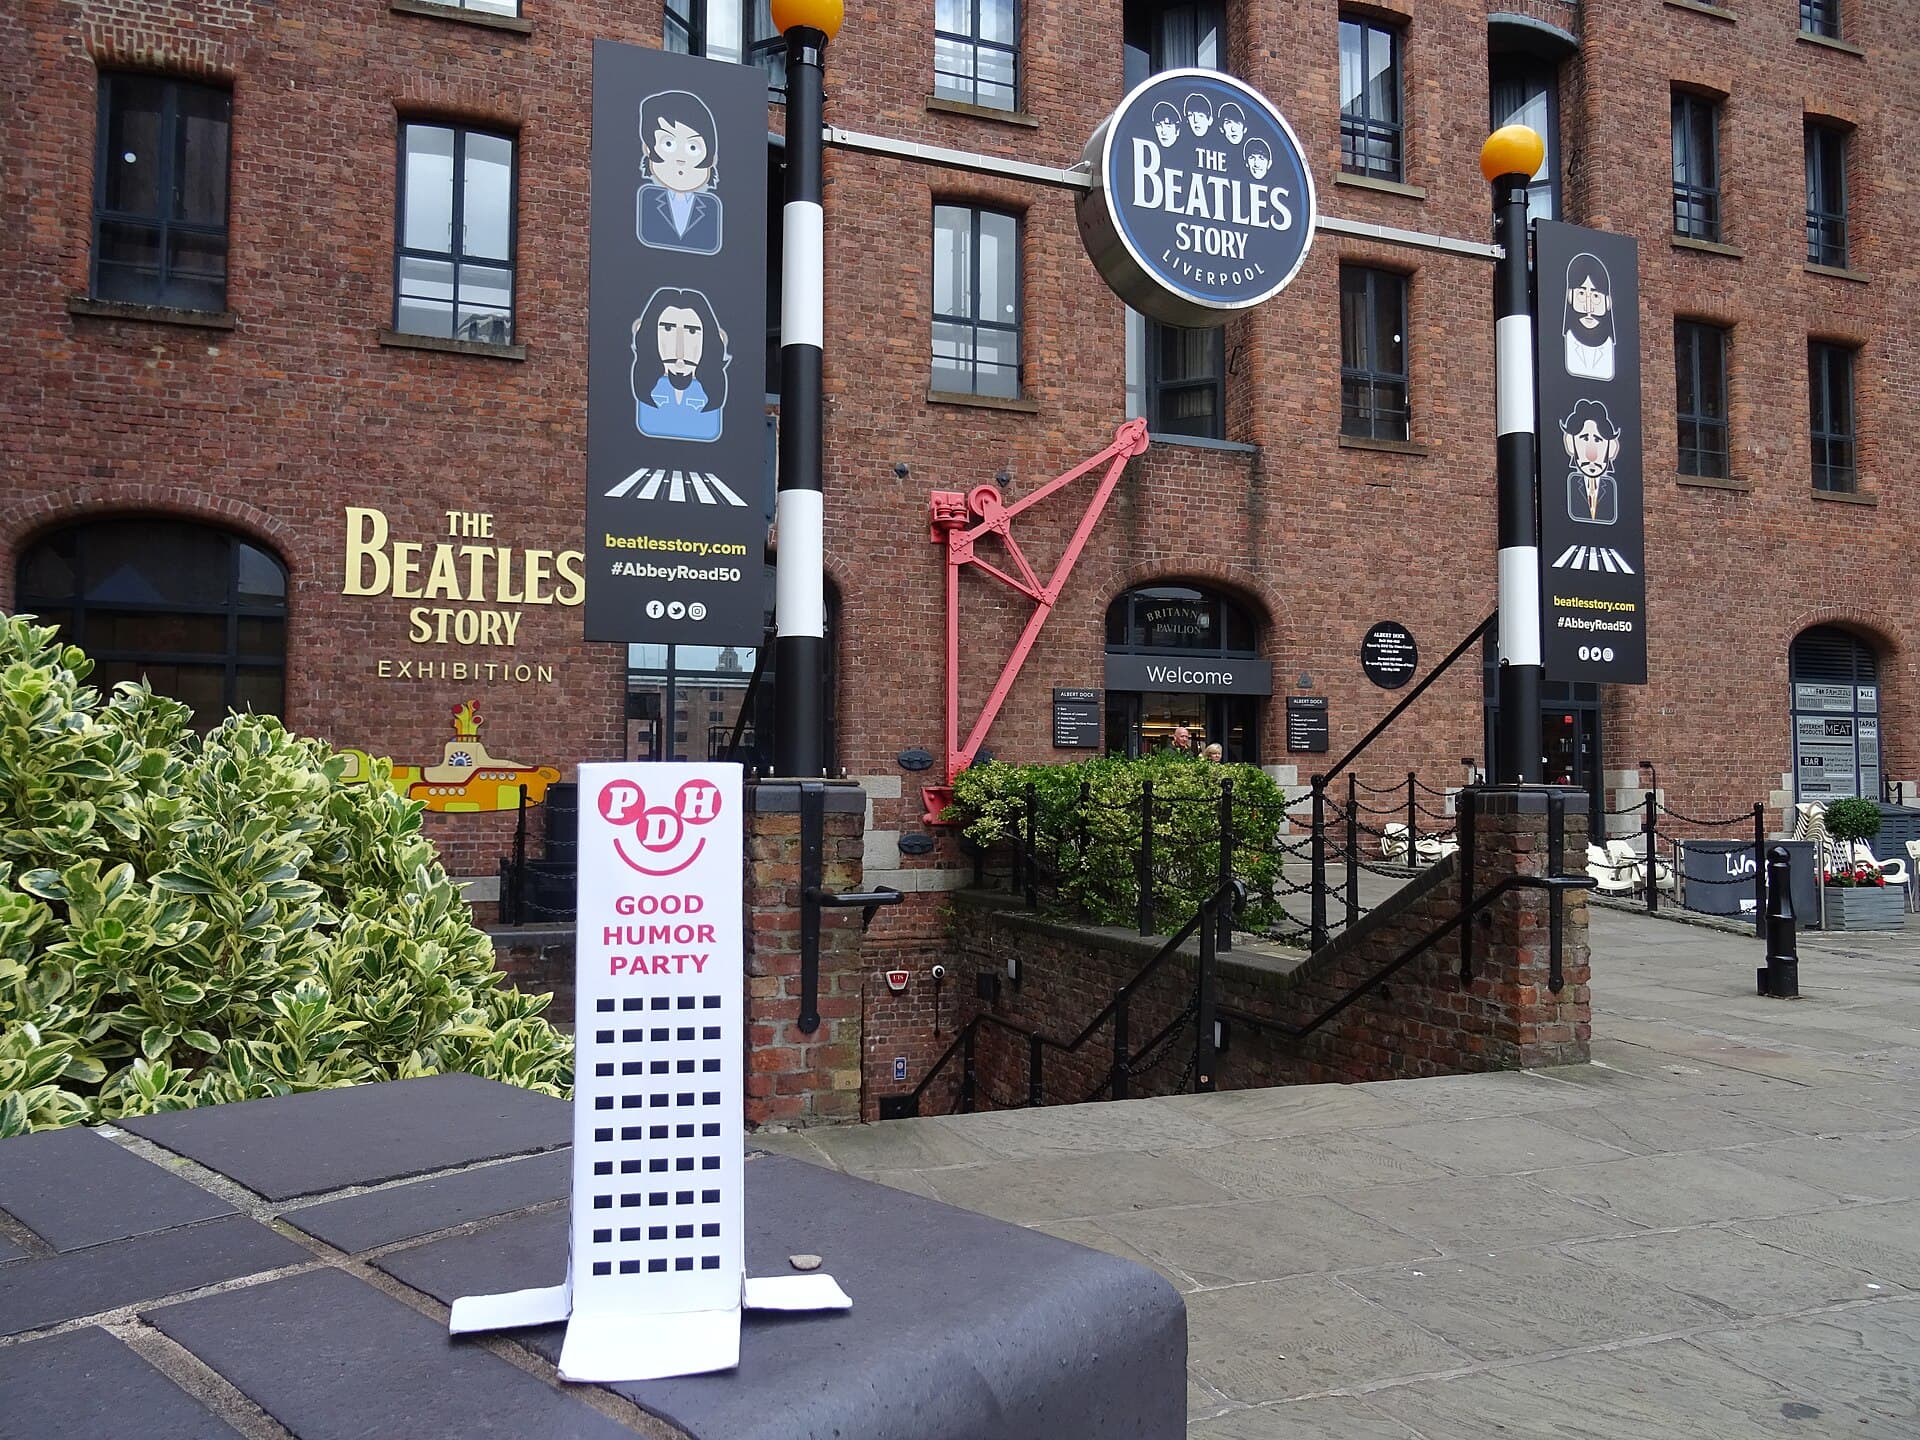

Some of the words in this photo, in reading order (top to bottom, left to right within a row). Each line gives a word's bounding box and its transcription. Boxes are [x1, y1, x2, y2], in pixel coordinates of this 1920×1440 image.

[1195, 148, 1227, 172] THE
[1132, 137, 1292, 231] BEATLES
[1175, 223, 1248, 259] STORY
[1162, 249, 1265, 286] LIVERPOOL
[446, 511, 494, 539] THE
[605, 533, 747, 556] beatlesstory.com
[342, 506, 585, 606] BEATLES
[611, 561, 741, 582] #AbbeyRoad50
[1553, 595, 1635, 612] beatlesstory.com
[409, 607, 522, 646] STORY
[1557, 617, 1632, 632] #AbbeyRoad50
[378, 660, 552, 682] EXHIBITION
[1146, 665, 1233, 685] Welcome
[1825, 724, 1851, 735] MEAT
[1859, 720, 1876, 728] TAPAS
[1804, 757, 1819, 766] BAR
[615, 895, 704, 915] GOOD
[603, 924, 717, 945] HUMOR
[610, 954, 710, 976] PARTY
